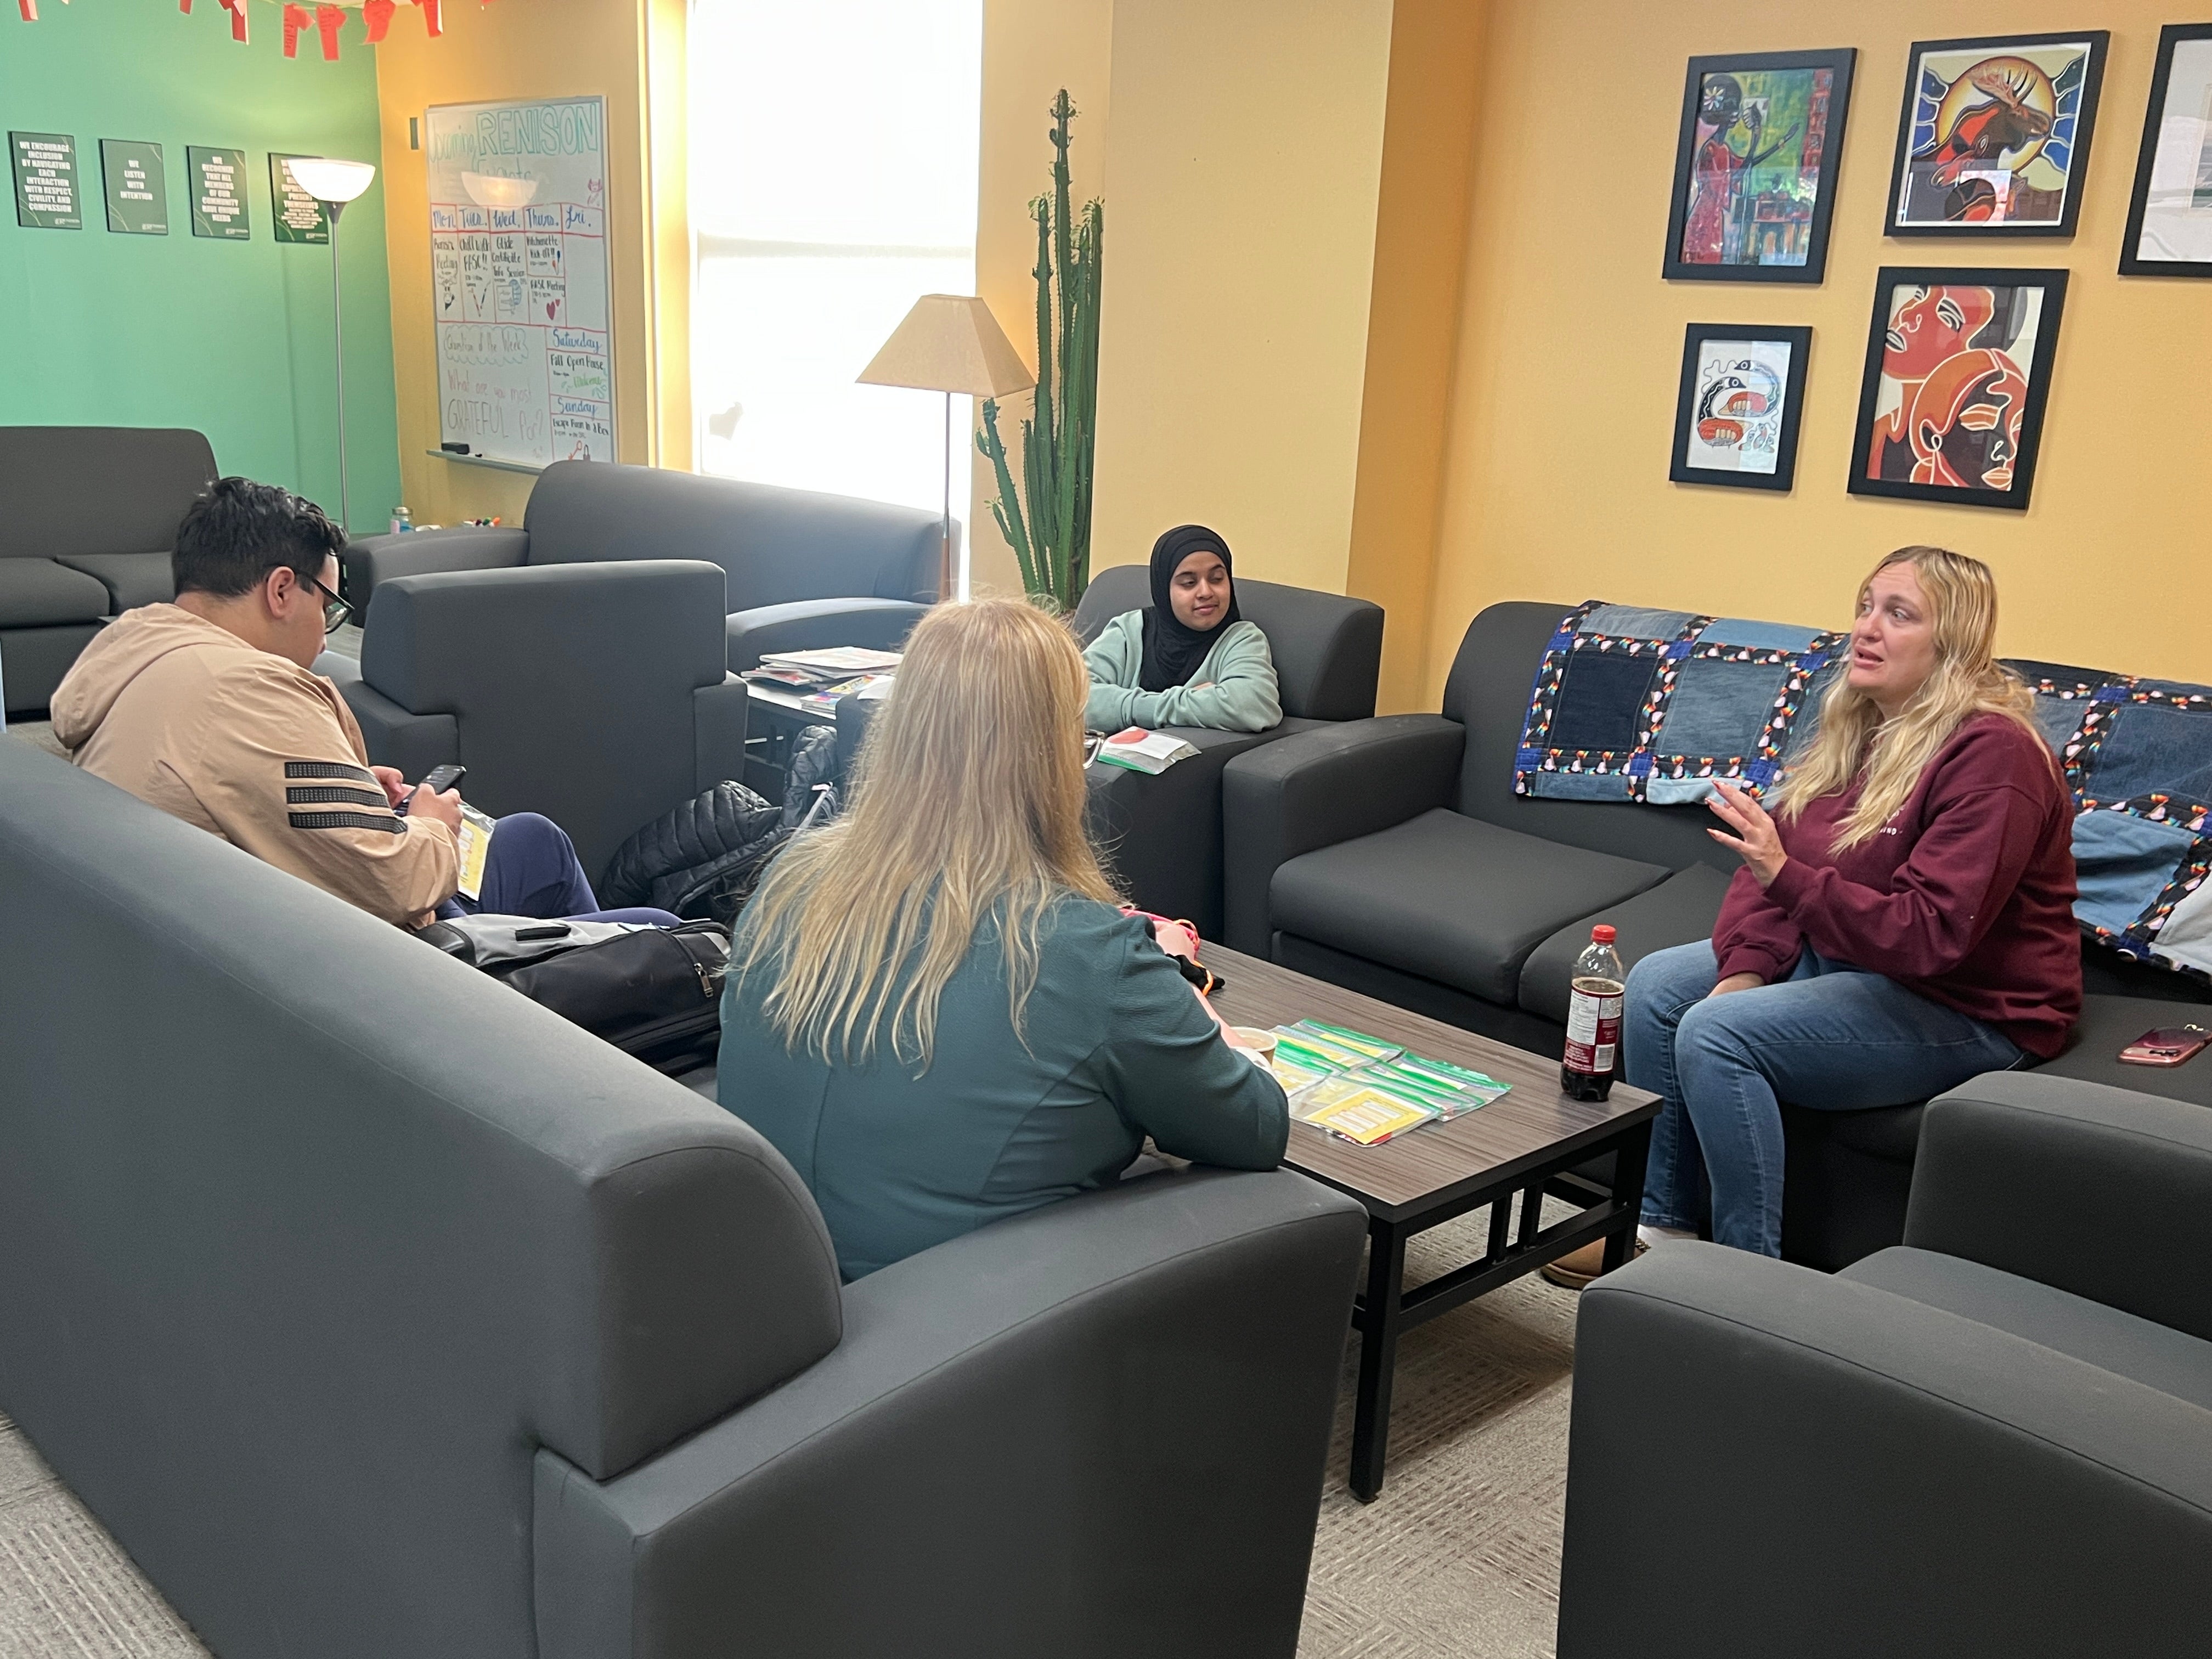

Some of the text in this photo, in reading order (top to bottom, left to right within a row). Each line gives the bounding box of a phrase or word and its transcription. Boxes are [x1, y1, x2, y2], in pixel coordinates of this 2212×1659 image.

[476, 103, 598, 156] RENISON
[19, 141, 70, 153] WE ENCOURAGE
[28, 150, 63, 160] INCLUSION
[22, 159, 71, 170] BY NAVIGATING
[128, 160, 139, 168] WE
[38, 168, 55, 177] EACH
[124, 170, 146, 179] LISTEN
[26, 176, 69, 187] INTERACTION
[127, 180, 144, 189] WITH
[24, 185, 72, 196] WITH RESPECT,
[120, 190, 153, 201] INTENTION
[57, 195, 71, 204] AND
[29, 202, 72, 213] COMPASSION
[553, 328, 602, 354] Saturday
[551, 354, 603, 371] Fall Open House
[557, 396, 597, 421] Sunday
[447, 398, 509, 439] GRATEFUL
